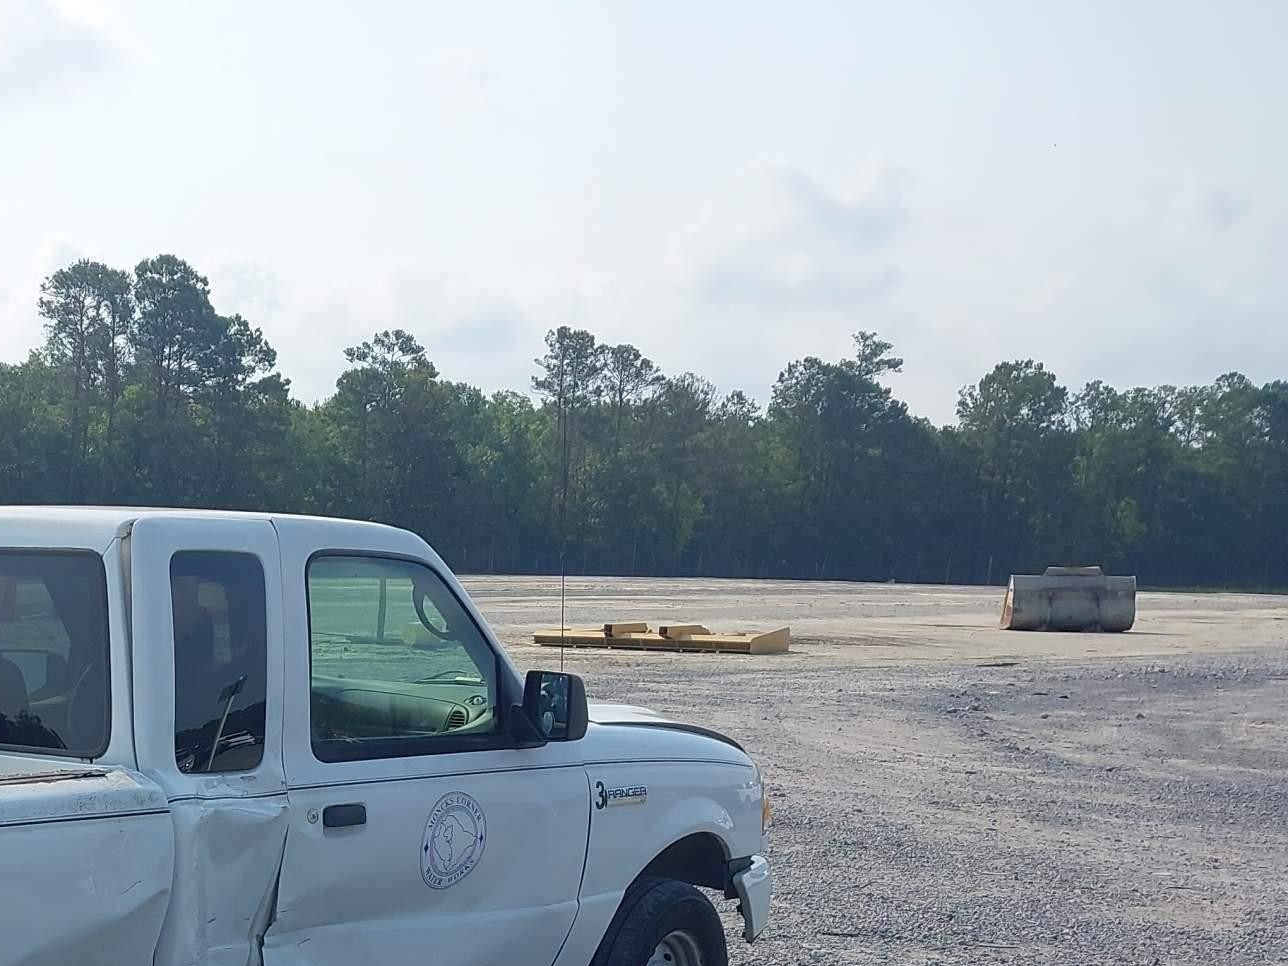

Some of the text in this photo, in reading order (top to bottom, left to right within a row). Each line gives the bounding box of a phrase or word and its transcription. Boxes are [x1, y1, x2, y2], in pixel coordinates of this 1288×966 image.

[607, 786, 647, 799] RANGER
[427, 796, 482, 831] MONCKS CORNER
[424, 866, 443, 886] WATER
